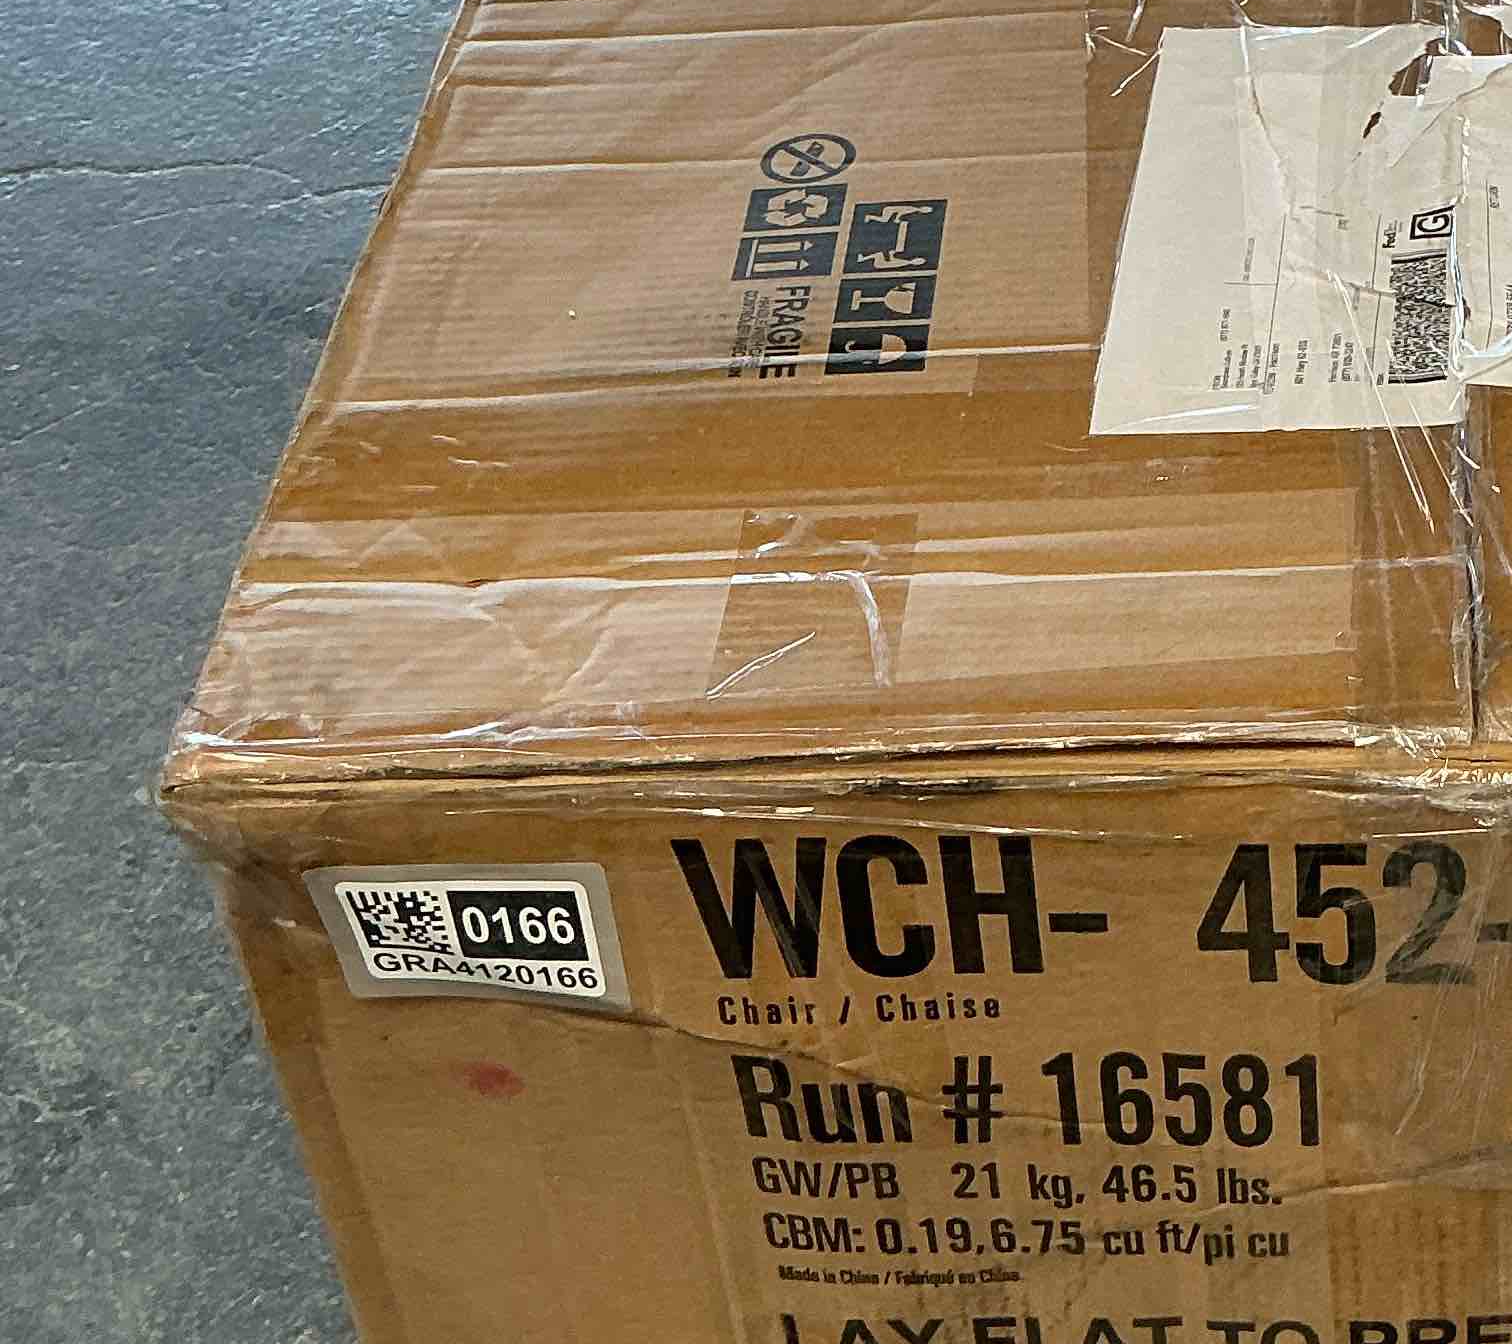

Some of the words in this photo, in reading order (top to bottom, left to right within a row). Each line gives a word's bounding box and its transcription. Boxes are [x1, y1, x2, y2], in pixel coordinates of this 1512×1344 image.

[1417, 213, 1449, 233] G
[759, 285, 811, 379] FRAGILE
[460, 905, 576, 945] 0166
[372, 952, 599, 989] GRA4120166
[717, 993, 817, 1026] Chair
[837, 995, 851, 1026] /
[875, 990, 1001, 1023] Chaise
[731, 1054, 913, 1144] Run
[942, 1056, 1004, 1144] #
[1041, 1051, 1319, 1147] 16581
[752, 1156, 900, 1199] GW/PB
[951, 1162, 1000, 1199] 21
[1028, 1163, 1086, 1209] kg,
[1101, 1164, 1197, 1204] 46.5
[1217, 1167, 1284, 1206] lbs.
[763, 1212, 866, 1254] CBM:
[875, 1217, 1086, 1256] 0.19,6.75
[1102, 1227, 1146, 1257] cu
[1248, 1229, 1291, 1259] cu
[778, 1265, 820, 1283] Made
[823, 1268, 837, 1284] in
[839, 1269, 880, 1285] China
